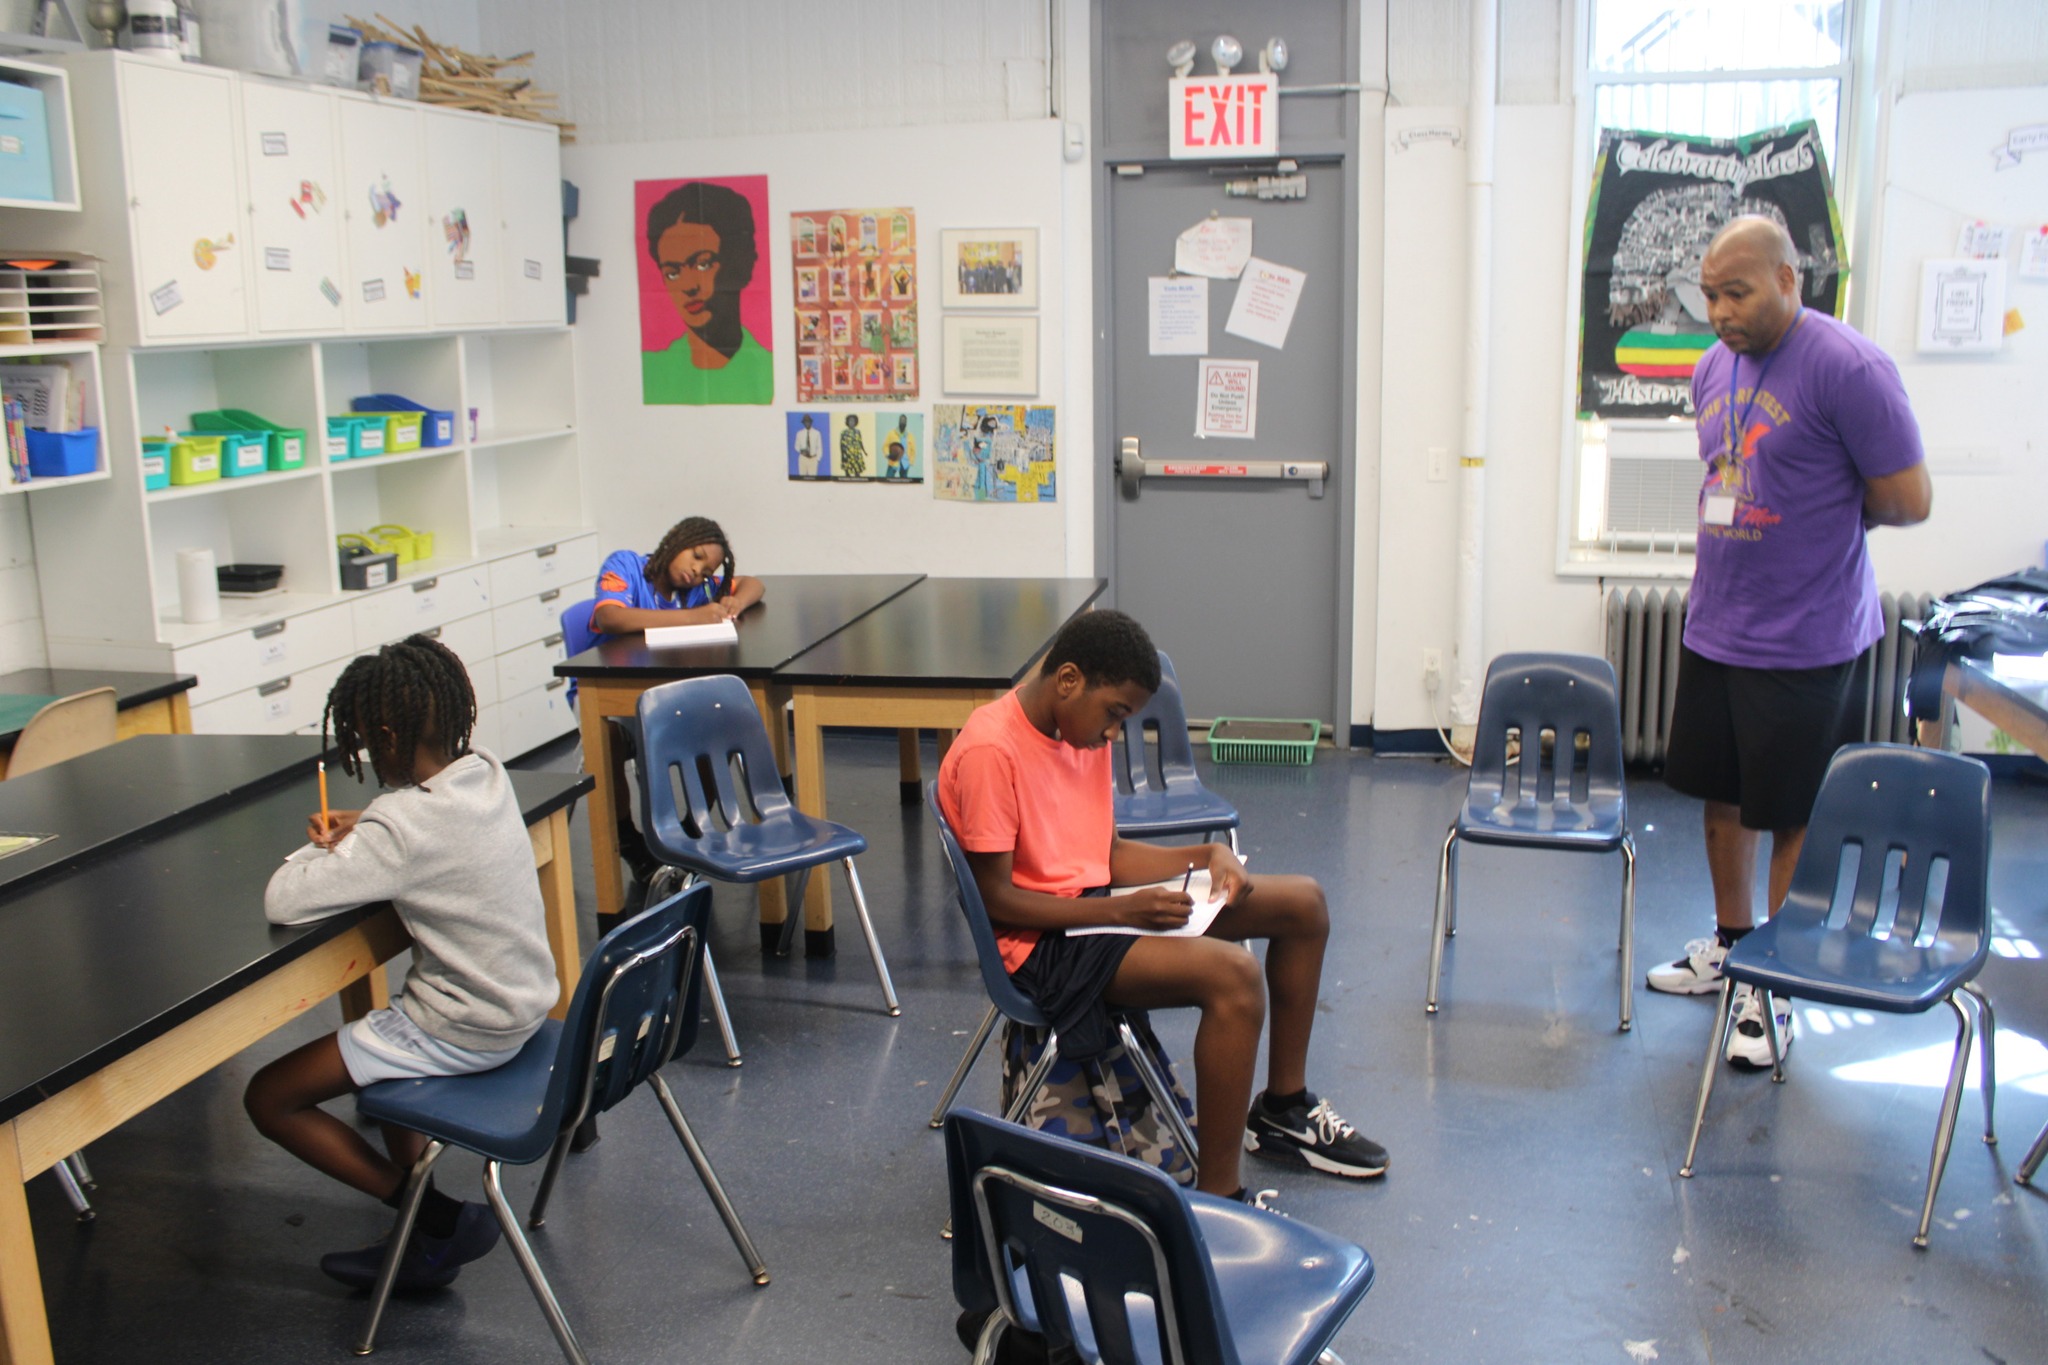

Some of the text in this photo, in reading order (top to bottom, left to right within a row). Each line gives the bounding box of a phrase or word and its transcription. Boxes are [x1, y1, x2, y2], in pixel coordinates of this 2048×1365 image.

[1185, 84, 1267, 146] EXIT
[1225, 371, 1248, 379] ALARM
[1599, 374, 1695, 414] History
[1211, 404, 1242, 412] Emergency
[1723, 528, 1763, 541] WORLD
